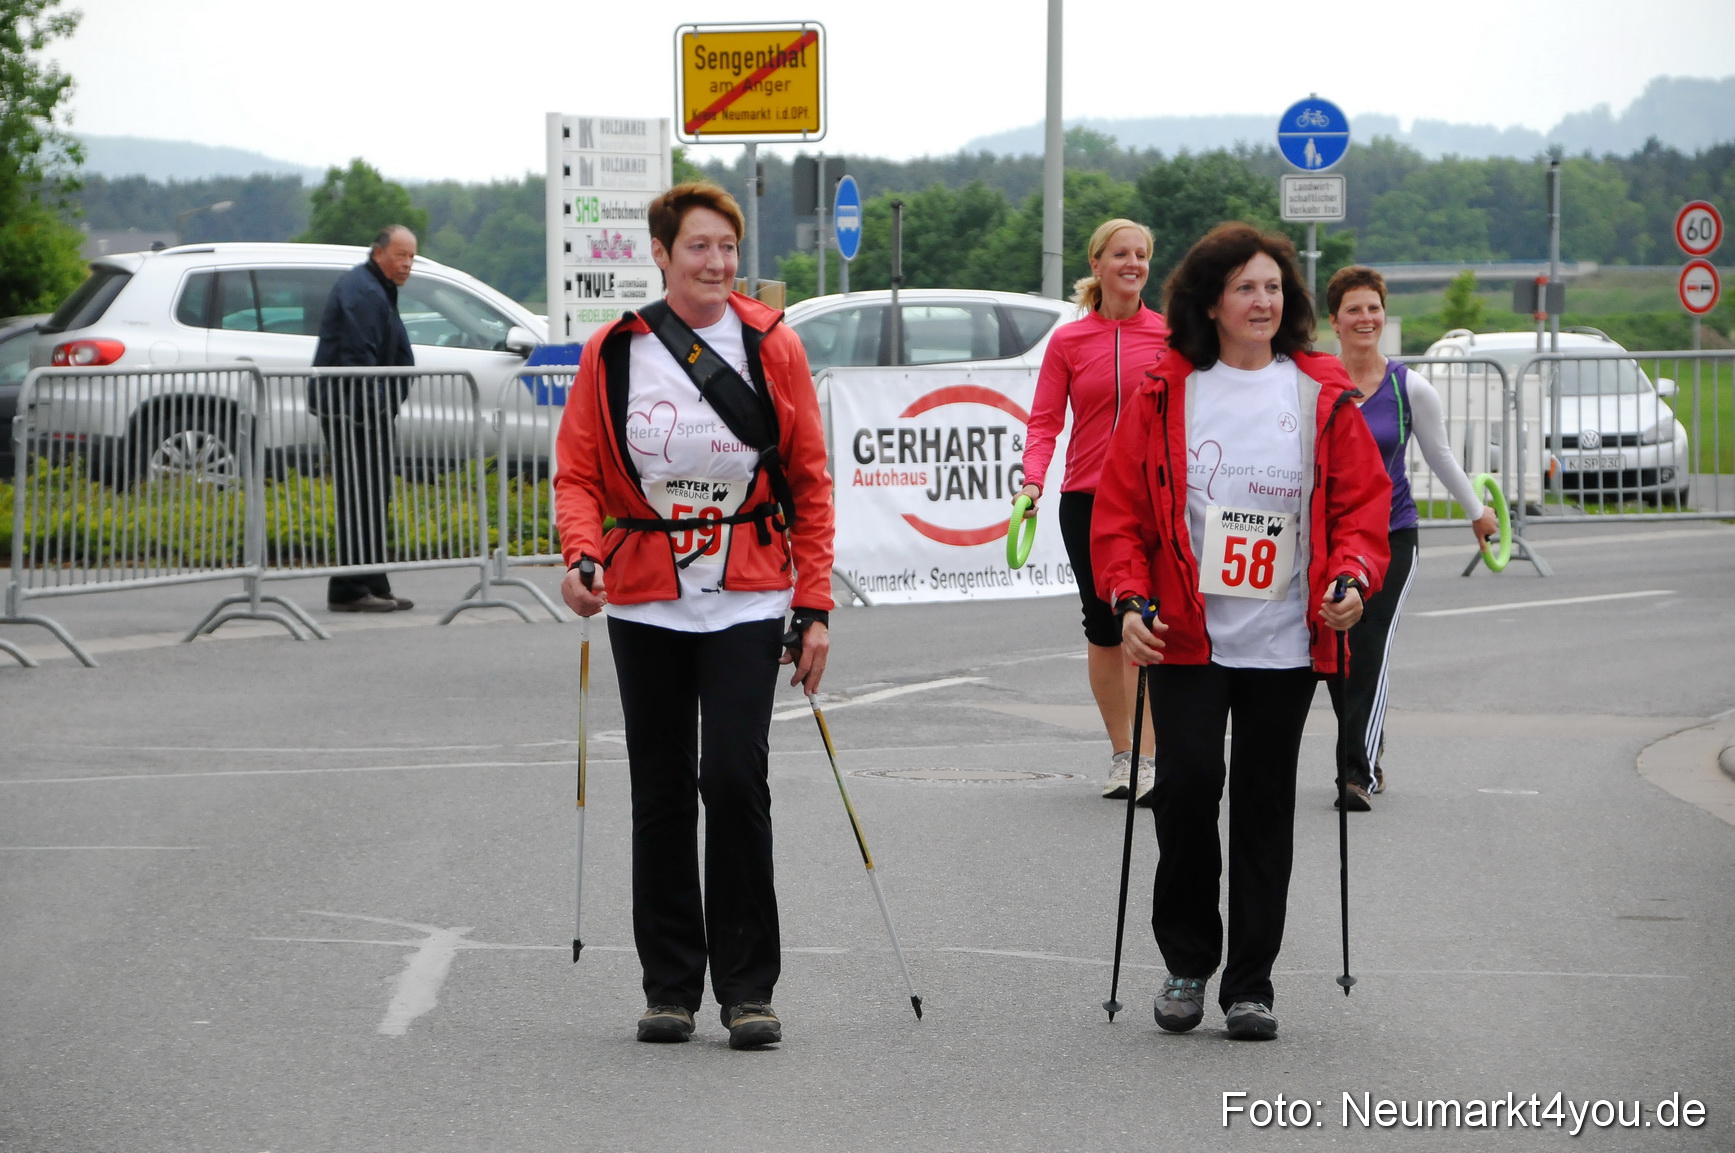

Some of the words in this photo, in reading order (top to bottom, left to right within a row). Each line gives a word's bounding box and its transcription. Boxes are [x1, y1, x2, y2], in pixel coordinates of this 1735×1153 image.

[694, 43, 806, 76] Sengenthal
[709, 81, 733, 92] am
[743, 79, 791, 96] Anger
[692, 108, 717, 120] Kreis
[722, 107, 771, 120] Neumarkt
[601, 119, 646, 136] HOLZAMMER
[601, 157, 647, 173] HOLZAMMER
[1687, 217, 1712, 240] 60
[575, 272, 615, 298] THULE
[629, 426, 660, 440] Herz
[677, 421, 716, 436] Sport
[853, 426, 1007, 464] GERHART
[1012, 433, 1023, 452] &
[852, 468, 927, 487] Autohaus
[926, 462, 1024, 502] JÄNIG
[1187, 464, 1206, 474] erz
[1220, 463, 1255, 478] Sport
[1267, 466, 1302, 483] Grupp
[666, 480, 709, 492] MEYER
[666, 488, 709, 500] WERBUNG
[1221, 511, 1264, 525] MEYER
[1221, 521, 1264, 533] WERBUNG
[671, 503, 723, 556] 59
[1221, 535, 1277, 590] 58
[849, 567, 917, 593] Neumarkt
[930, 564, 1013, 594] Sengenthal
[1026, 564, 1053, 586] Tel.
